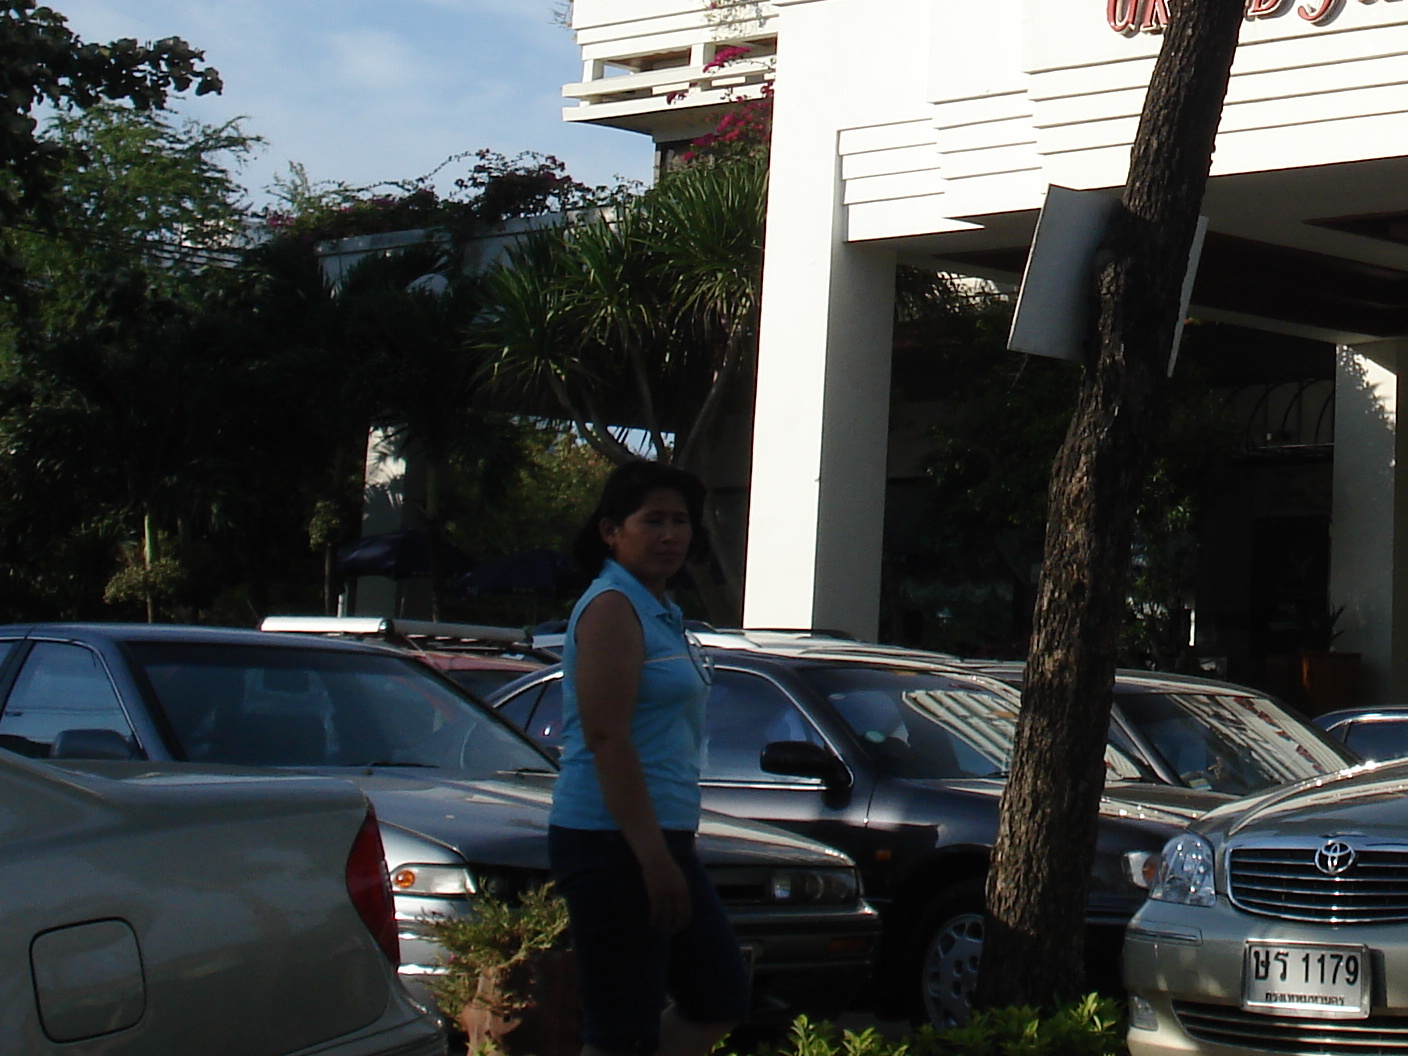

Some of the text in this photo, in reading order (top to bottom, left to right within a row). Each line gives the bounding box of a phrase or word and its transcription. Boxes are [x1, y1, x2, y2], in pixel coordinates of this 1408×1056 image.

[1302, 952, 1359, 986] 1179
[1265, 991, 1345, 1006] กรงเทพมหานคร
